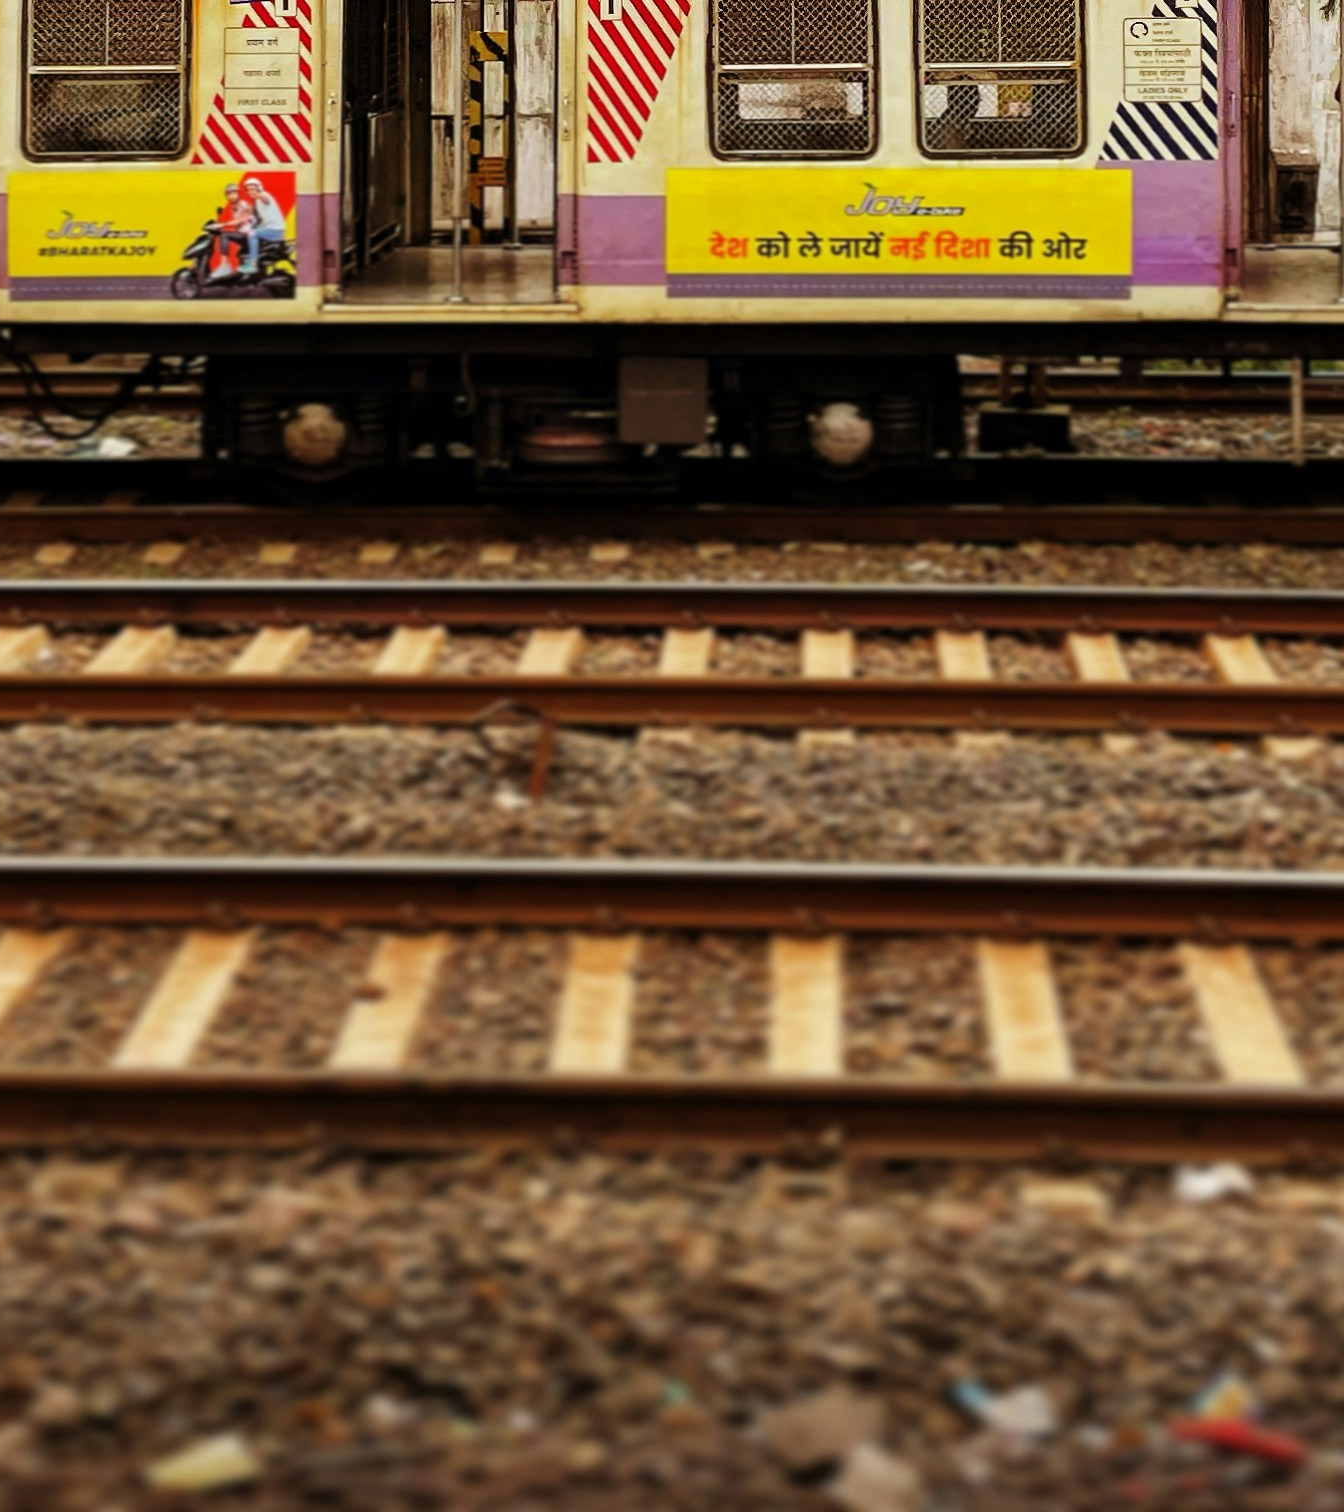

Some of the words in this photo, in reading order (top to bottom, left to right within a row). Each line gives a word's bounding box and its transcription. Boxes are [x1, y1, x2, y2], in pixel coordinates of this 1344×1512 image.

[237, 98, 260, 106] FIRST
[261, 98, 287, 106] CLASS
[709, 230, 749, 259] देश
[755, 230, 791, 259] को
[797, 230, 823, 258] ले
[828, 230, 884, 259] जायें
[888, 230, 931, 260] नई
[934, 230, 991, 260] दिशा
[998, 230, 1034, 259] की
[1042, 231, 1088, 260] ओर
